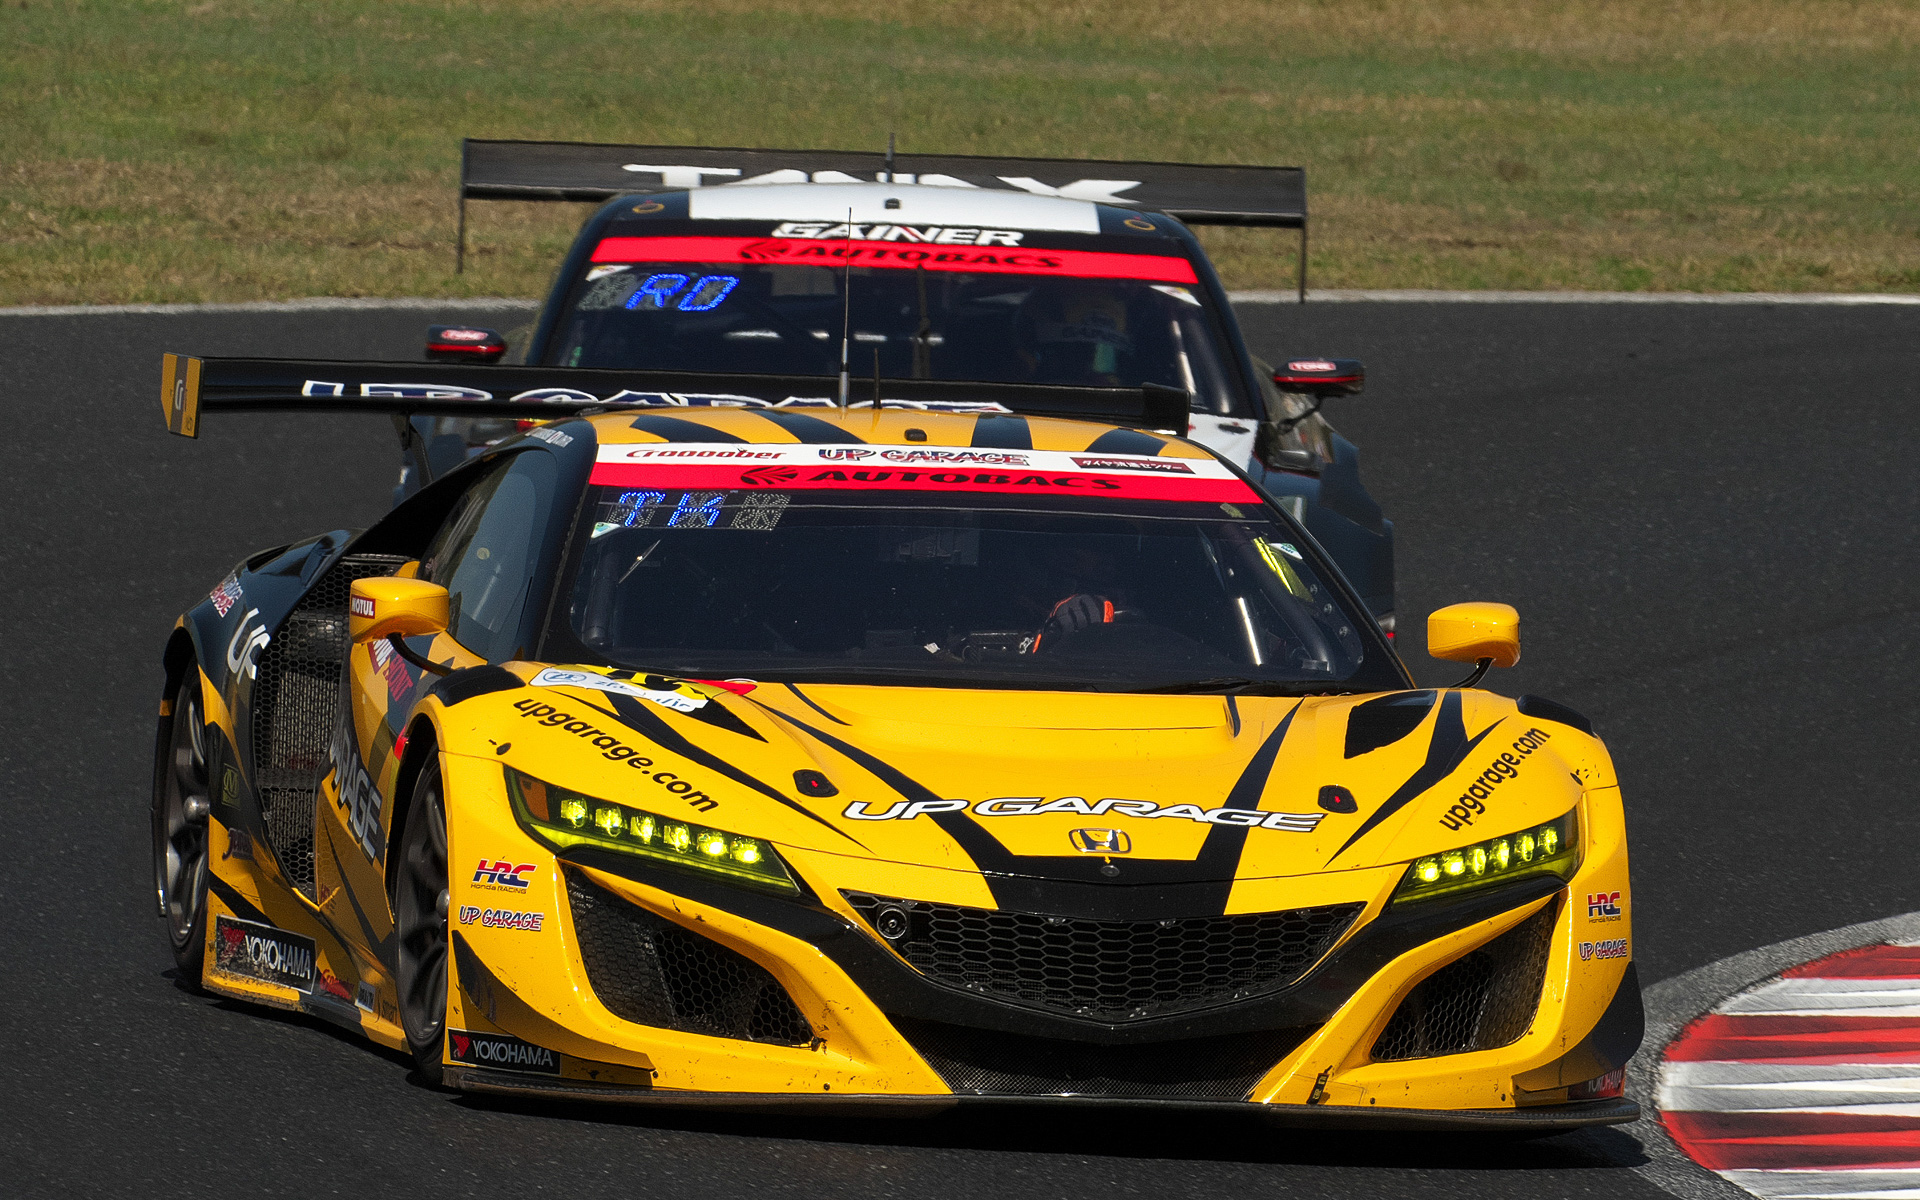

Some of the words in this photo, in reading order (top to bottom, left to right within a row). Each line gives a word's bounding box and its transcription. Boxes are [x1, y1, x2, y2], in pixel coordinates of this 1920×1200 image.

[771, 222, 1024, 247] GAINER
[792, 246, 1063, 268] AUTOBACS
[818, 448, 876, 462] UP
[880, 450, 1030, 467] GARAGE
[808, 470, 1122, 490] AUTOBACS
[352, 597, 375, 617] MOTUL
[513, 698, 719, 814] upgarage.com
[1438, 727, 1552, 832] upgarage.com
[840, 798, 970, 821] UP
[974, 797, 1328, 833] GARAGE
[472, 858, 537, 888] HRC
[470, 883, 497, 892] Honda
[497, 886, 527, 895] RACING
[1587, 890, 1621, 918] HRC
[459, 905, 481, 925] UP
[481, 908, 544, 932] GARAGE
[245, 935, 311, 980] YOKOHAMA
[1578, 941, 1594, 962] UP
[1594, 938, 1628, 960] GARAGE
[472, 1039, 554, 1067] YOKOHAMA
